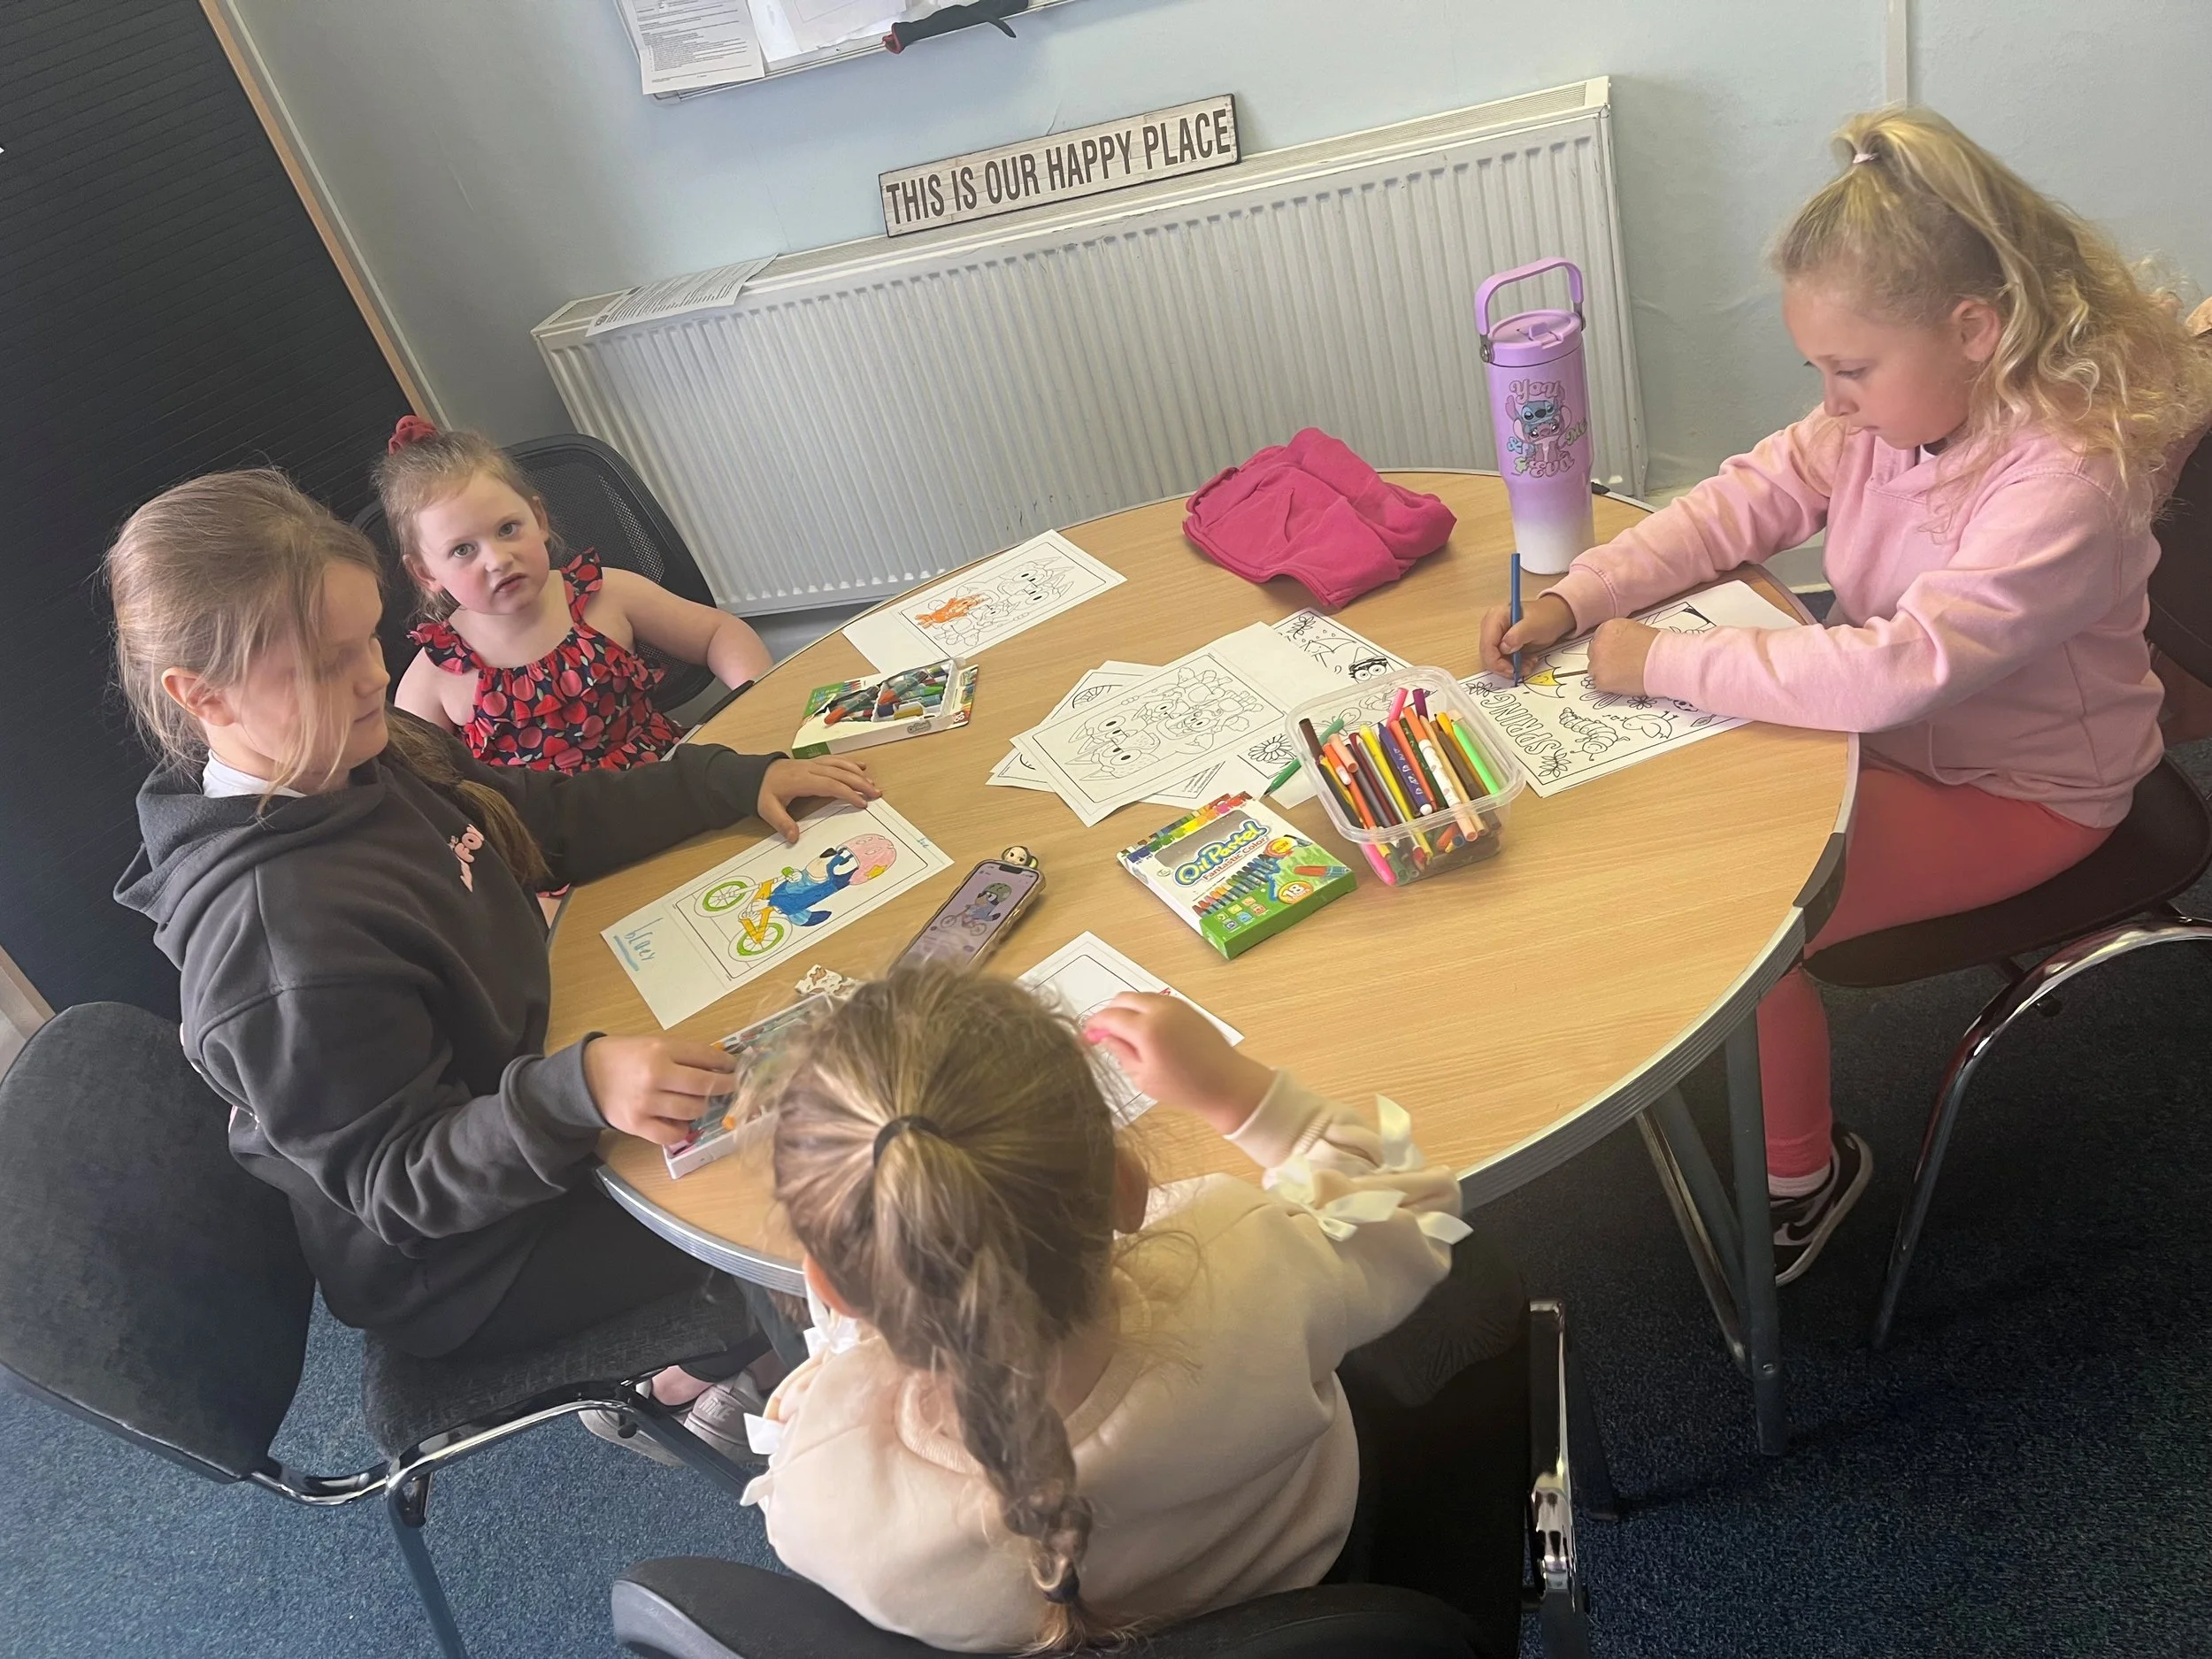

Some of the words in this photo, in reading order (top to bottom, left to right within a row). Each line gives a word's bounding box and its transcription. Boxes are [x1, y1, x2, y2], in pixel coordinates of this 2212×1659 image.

[886, 173, 945, 225] THIS
[950, 166, 978, 211] IS
[986, 153, 1041, 204] OUR
[1045, 129, 1133, 192] HAPPY
[1142, 108, 1232, 171] PLACE
[1479, 693, 1562, 755] SPRING
[1177, 855, 1213, 885] Oil
[1199, 821, 1266, 864] Pastel
[1203, 853, 1243, 879] Fantastic
[1242, 837, 1266, 854] Color
[1282, 883, 1305, 899] 18
